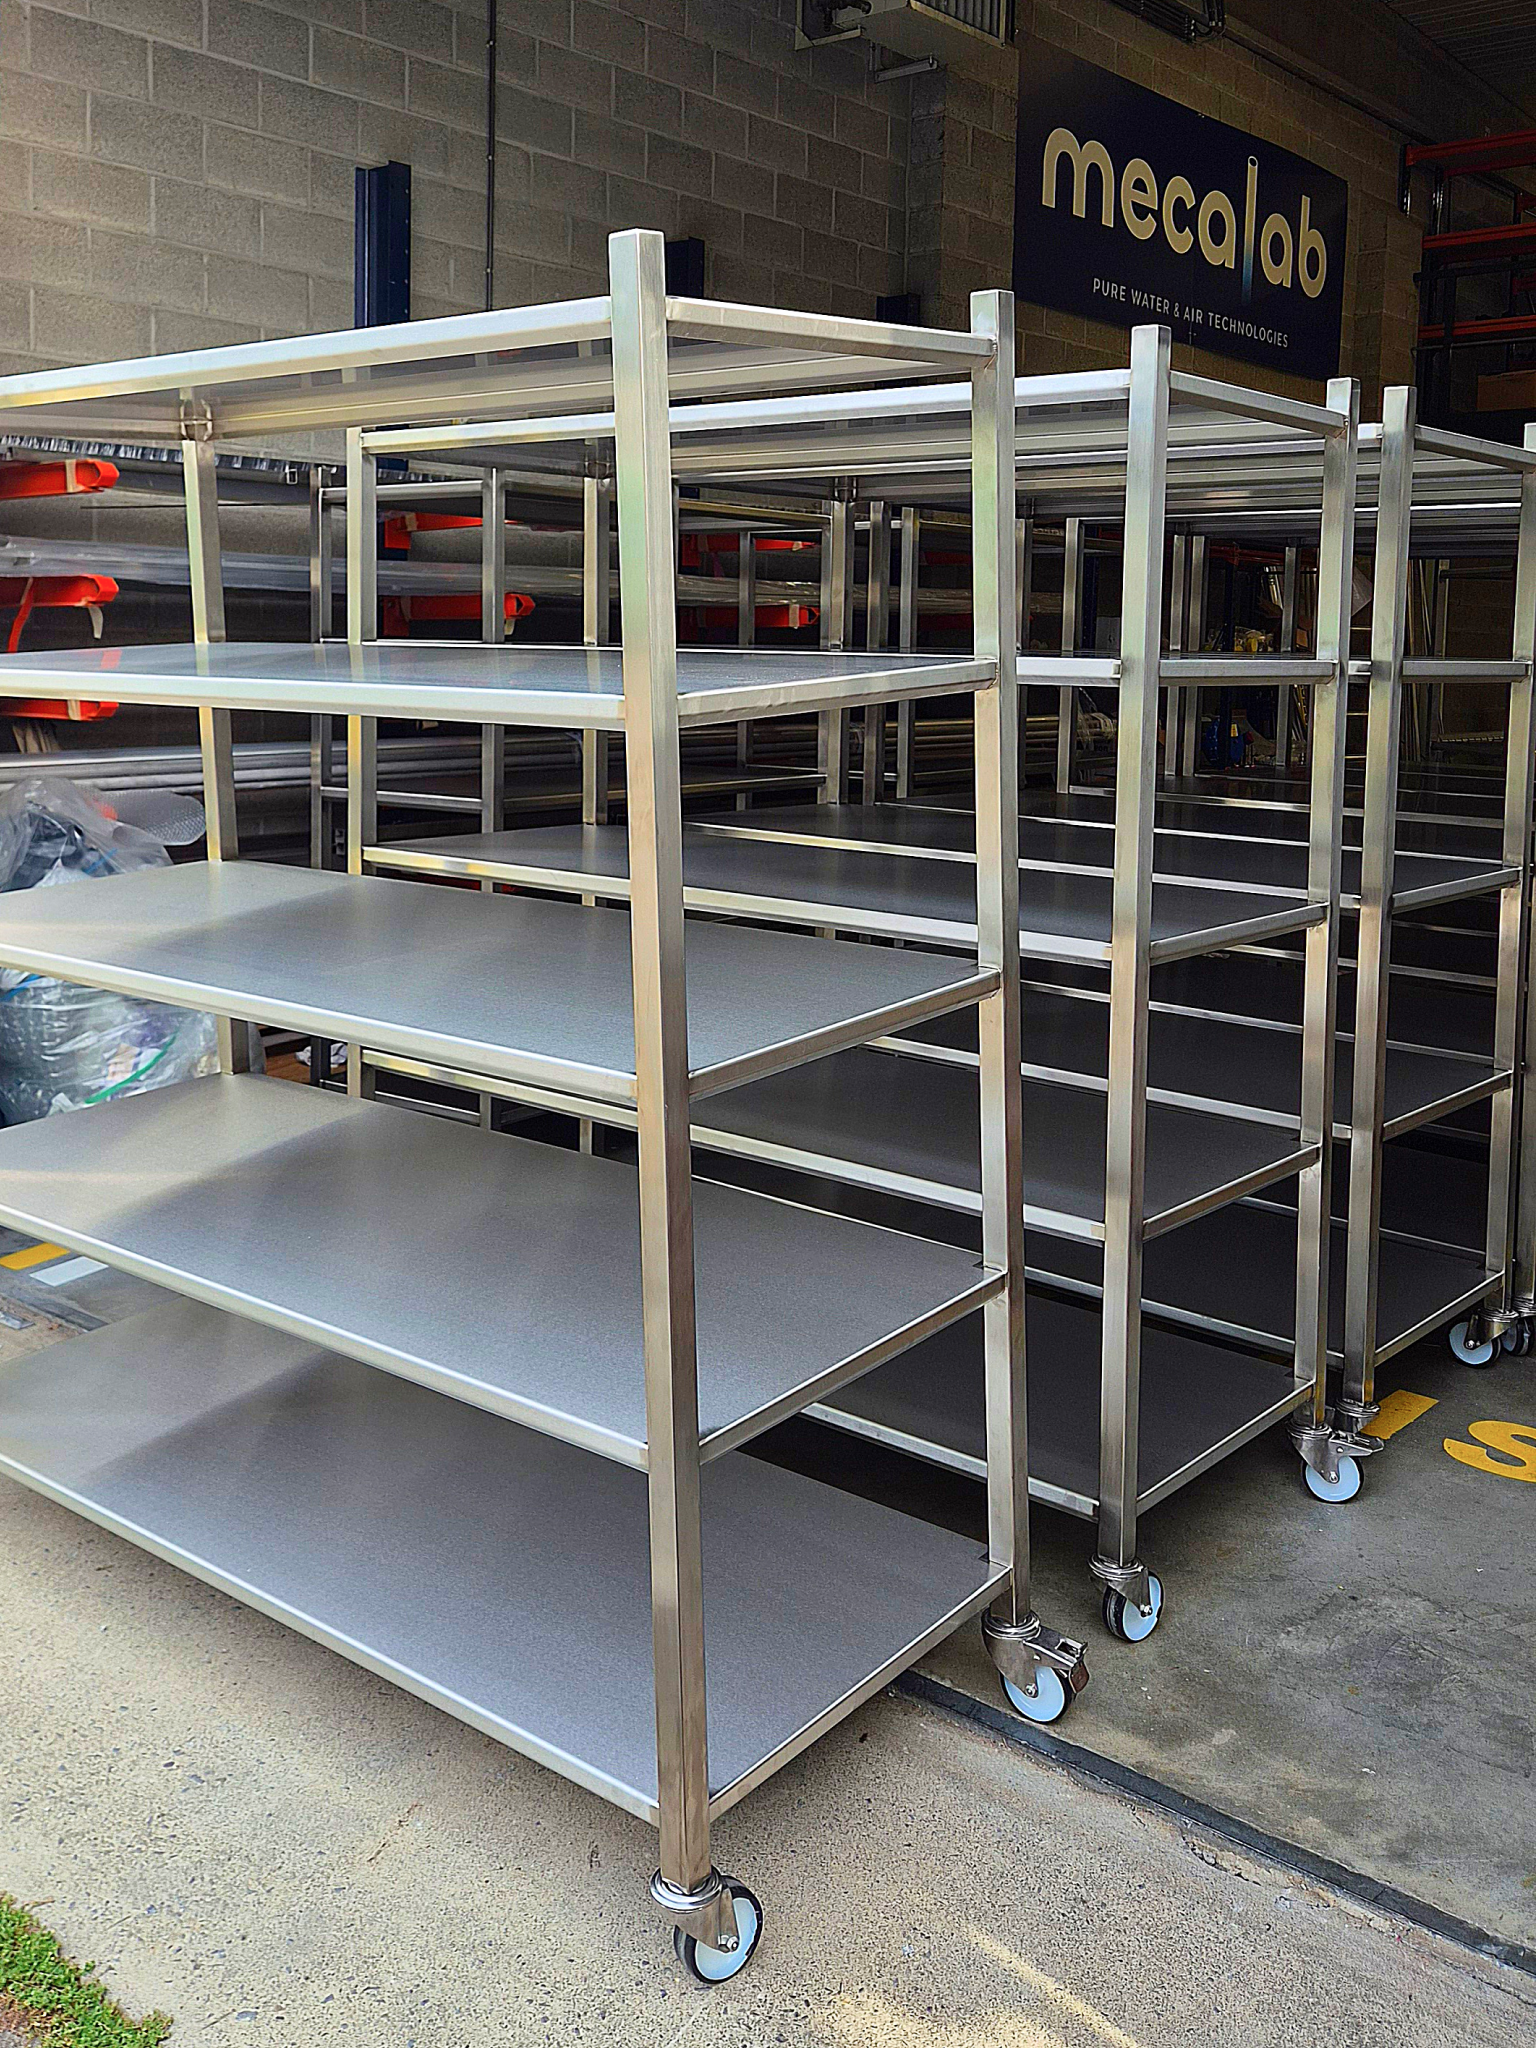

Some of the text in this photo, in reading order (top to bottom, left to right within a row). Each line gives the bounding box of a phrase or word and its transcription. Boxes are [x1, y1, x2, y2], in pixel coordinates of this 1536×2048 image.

[1042, 127, 1327, 301] mecalab
[1093, 277, 1289, 348] PURE WATER & AIR TECHNOLOGIES
